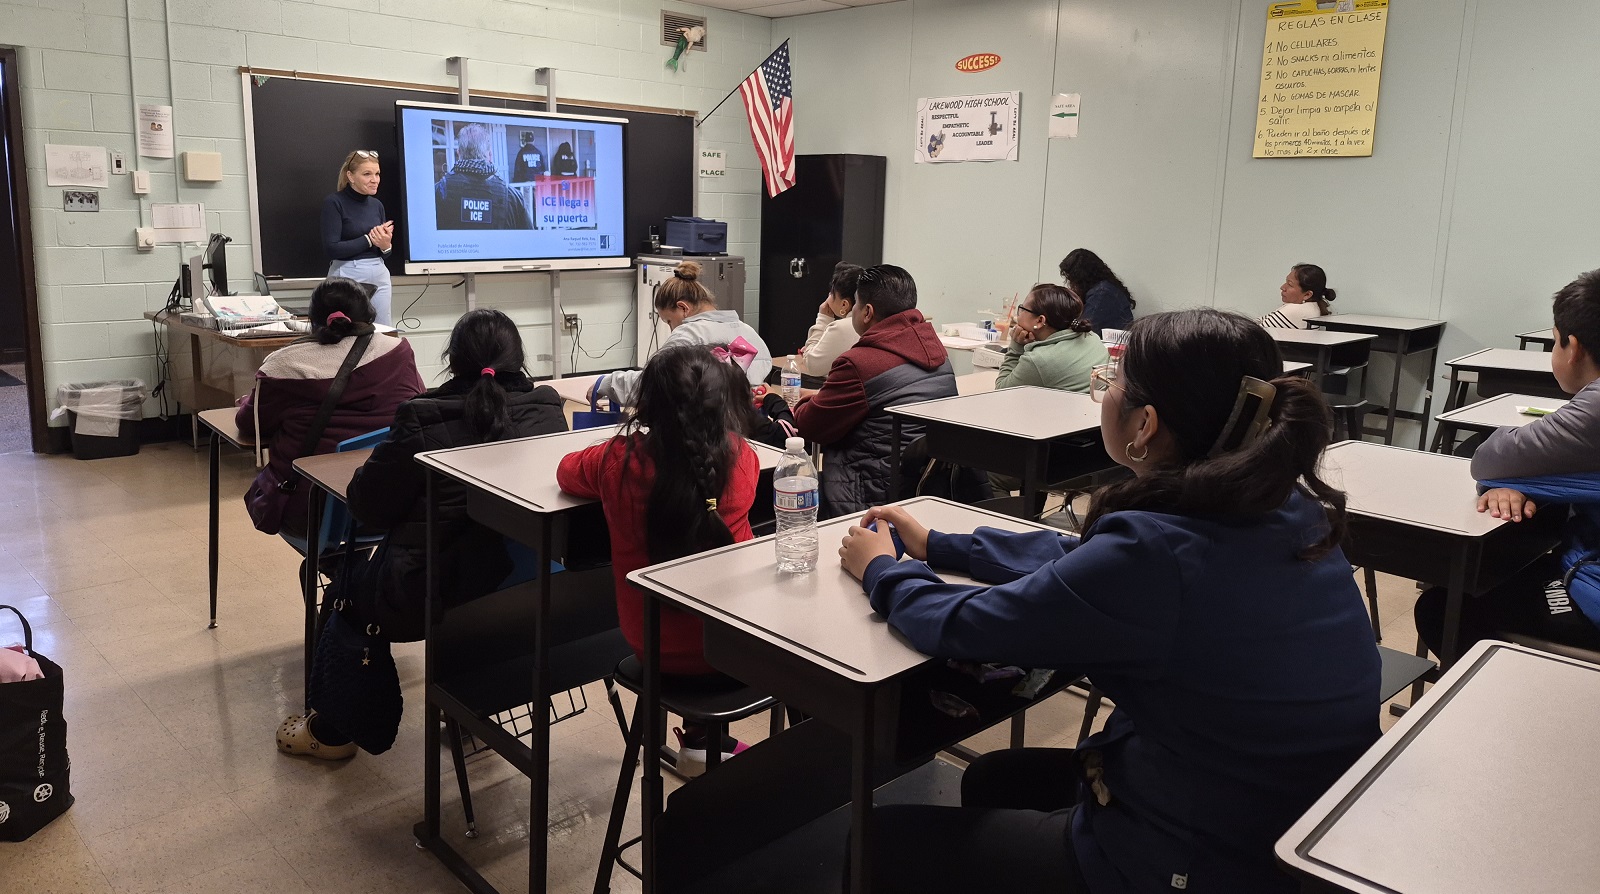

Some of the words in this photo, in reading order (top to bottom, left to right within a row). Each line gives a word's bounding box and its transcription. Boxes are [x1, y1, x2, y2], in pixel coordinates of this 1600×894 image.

[1278, 17, 1326, 32] REGLAS
[1330, 15, 1344, 25] EN
[1347, 11, 1382, 24] CLASE
[957, 55, 998, 70] SUCCESS!
[1290, 54, 1319, 64] SNACKS
[1358, 64, 1376, 73] lentes
[1290, 92, 1314, 100] GOMAS
[1316, 92, 1326, 100] DE
[929, 102, 962, 111] LAKEWOOD
[964, 99, 983, 108] HIGH
[984, 96, 1010, 107] SCHOOL
[1271, 106, 1294, 117] Dejar
[1296, 105, 1320, 119] limpia
[1334, 102, 1360, 115] carpeta
[1365, 101, 1374, 112] al
[1266, 128, 1292, 138] Pueden
[1302, 128, 1310, 136] al
[1312, 128, 1330, 136] baño
[1332, 126, 1358, 139] después
[1362, 128, 1370, 136] de
[1274, 140, 1302, 150] primeros
[464, 200, 490, 210] POLICE
[542, 196, 556, 206] ICE
[560, 196, 580, 209] llega
[470, 211, 482, 221] ICE
[544, 214, 554, 222] su
[558, 214, 588, 224] puerta
[1544, 589, 1572, 615] NBA
